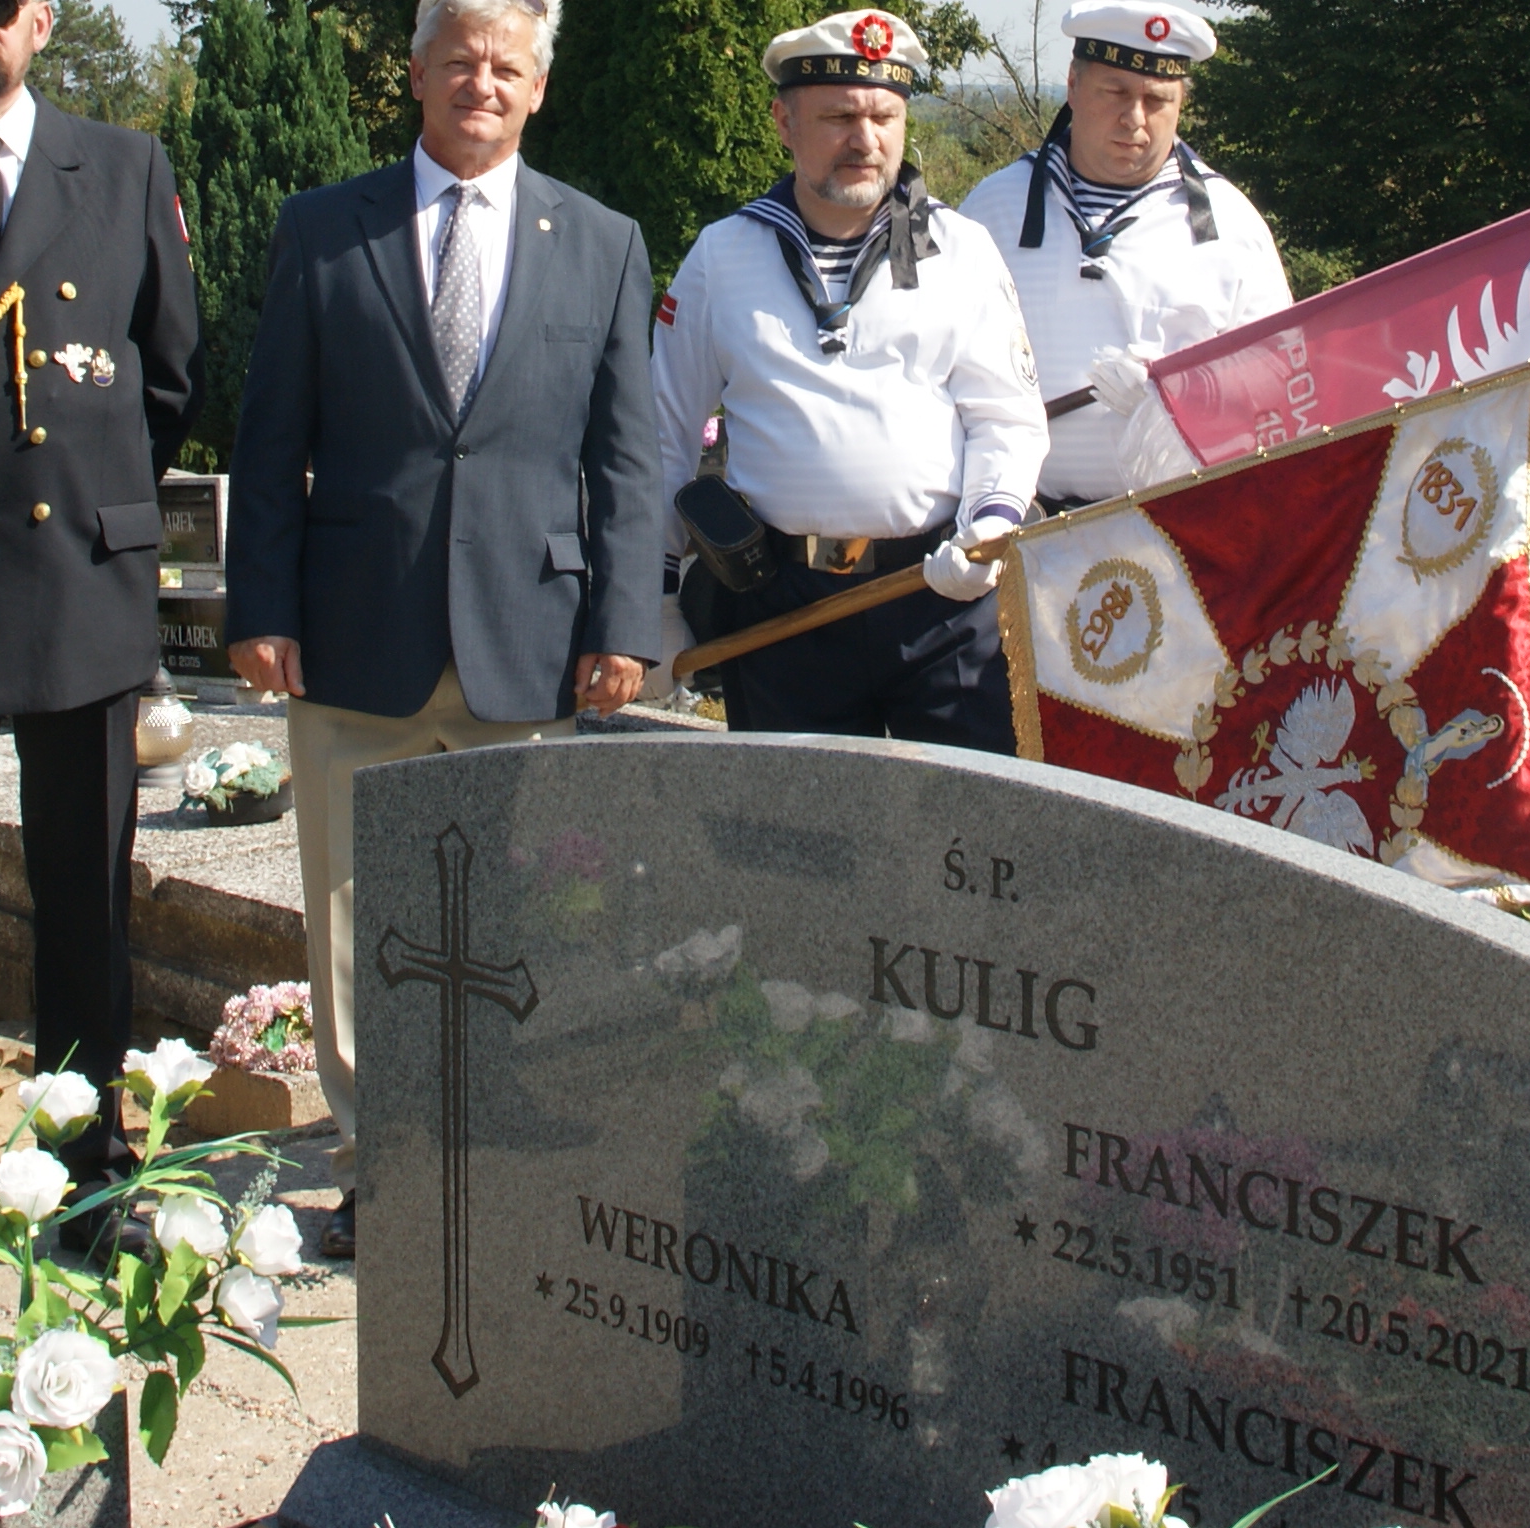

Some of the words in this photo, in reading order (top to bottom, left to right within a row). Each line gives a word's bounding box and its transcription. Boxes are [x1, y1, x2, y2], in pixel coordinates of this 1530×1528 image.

[1417, 460, 1478, 532] 1831
[1080, 580, 1134, 662] 1863
[868, 935, 1099, 1051] KULIG
[1062, 1122, 1484, 1285] FRANCISZEK
[577, 1194, 861, 1336] WERONIKA
[1051, 1219, 1241, 1310] 22.5.1951
[564, 1277, 710, 1359] 25.9.1909
[1061, 1347, 1480, 1528] FRANCISZEK
